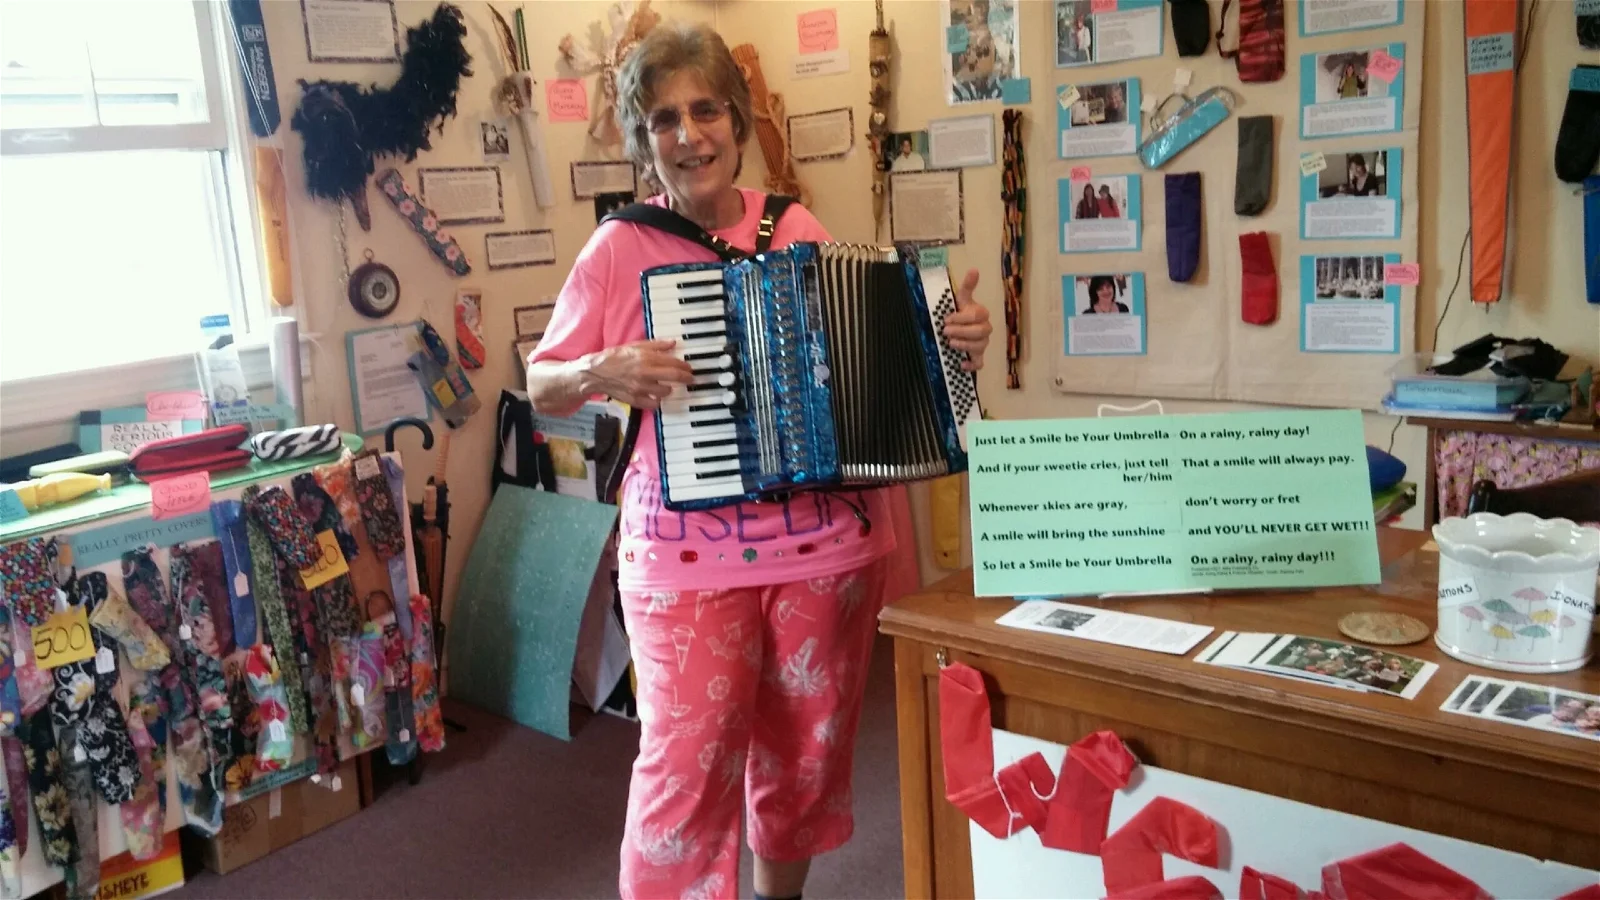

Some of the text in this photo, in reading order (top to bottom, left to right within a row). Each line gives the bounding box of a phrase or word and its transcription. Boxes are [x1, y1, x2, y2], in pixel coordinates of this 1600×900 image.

[112, 422, 170, 433] REALLY
[1180, 425, 1310, 440] On a rainy, rainy day!
[975, 435, 996, 446] Just
[1000, 435, 1016, 445] let
[1029, 433, 1061, 444] Smile
[1065, 433, 1079, 443] be
[1083, 432, 1109, 442] Your
[1113, 429, 1170, 441] Umbrella
[977, 458, 1169, 475] And if your sweetie cries, just tell
[1182, 457, 1210, 468] That
[1224, 456, 1256, 467] smile
[1259, 455, 1281, 466] will
[1284, 454, 1326, 467] always
[1329, 455, 1355, 466] pay.
[1123, 472, 1173, 483] her/him
[978, 501, 1128, 513] Whenever skies are gray,
[1221, 497, 1258, 508] worry
[1261, 496, 1275, 505] or
[1277, 494, 1301, 505] fret
[980, 526, 1165, 542] A smile will bring the sunshine
[1188, 525, 1212, 536] and
[1261, 523, 1302, 534] NEVER
[1304, 521, 1328, 532] GET
[1330, 520, 1370, 531] WET!!
[77, 537, 120, 555] REALLY
[124, 526, 165, 545] PRETTY
[983, 555, 1172, 570] So let a Smile be Your Umbrella
[1190, 555, 1209, 565] On
[1222, 554, 1258, 566] rainy,
[1261, 552, 1293, 565] rainy
[1297, 551, 1335, 564] day!!!
[34, 622, 87, 661] 500
[97, 872, 150, 900] ISHEYE
